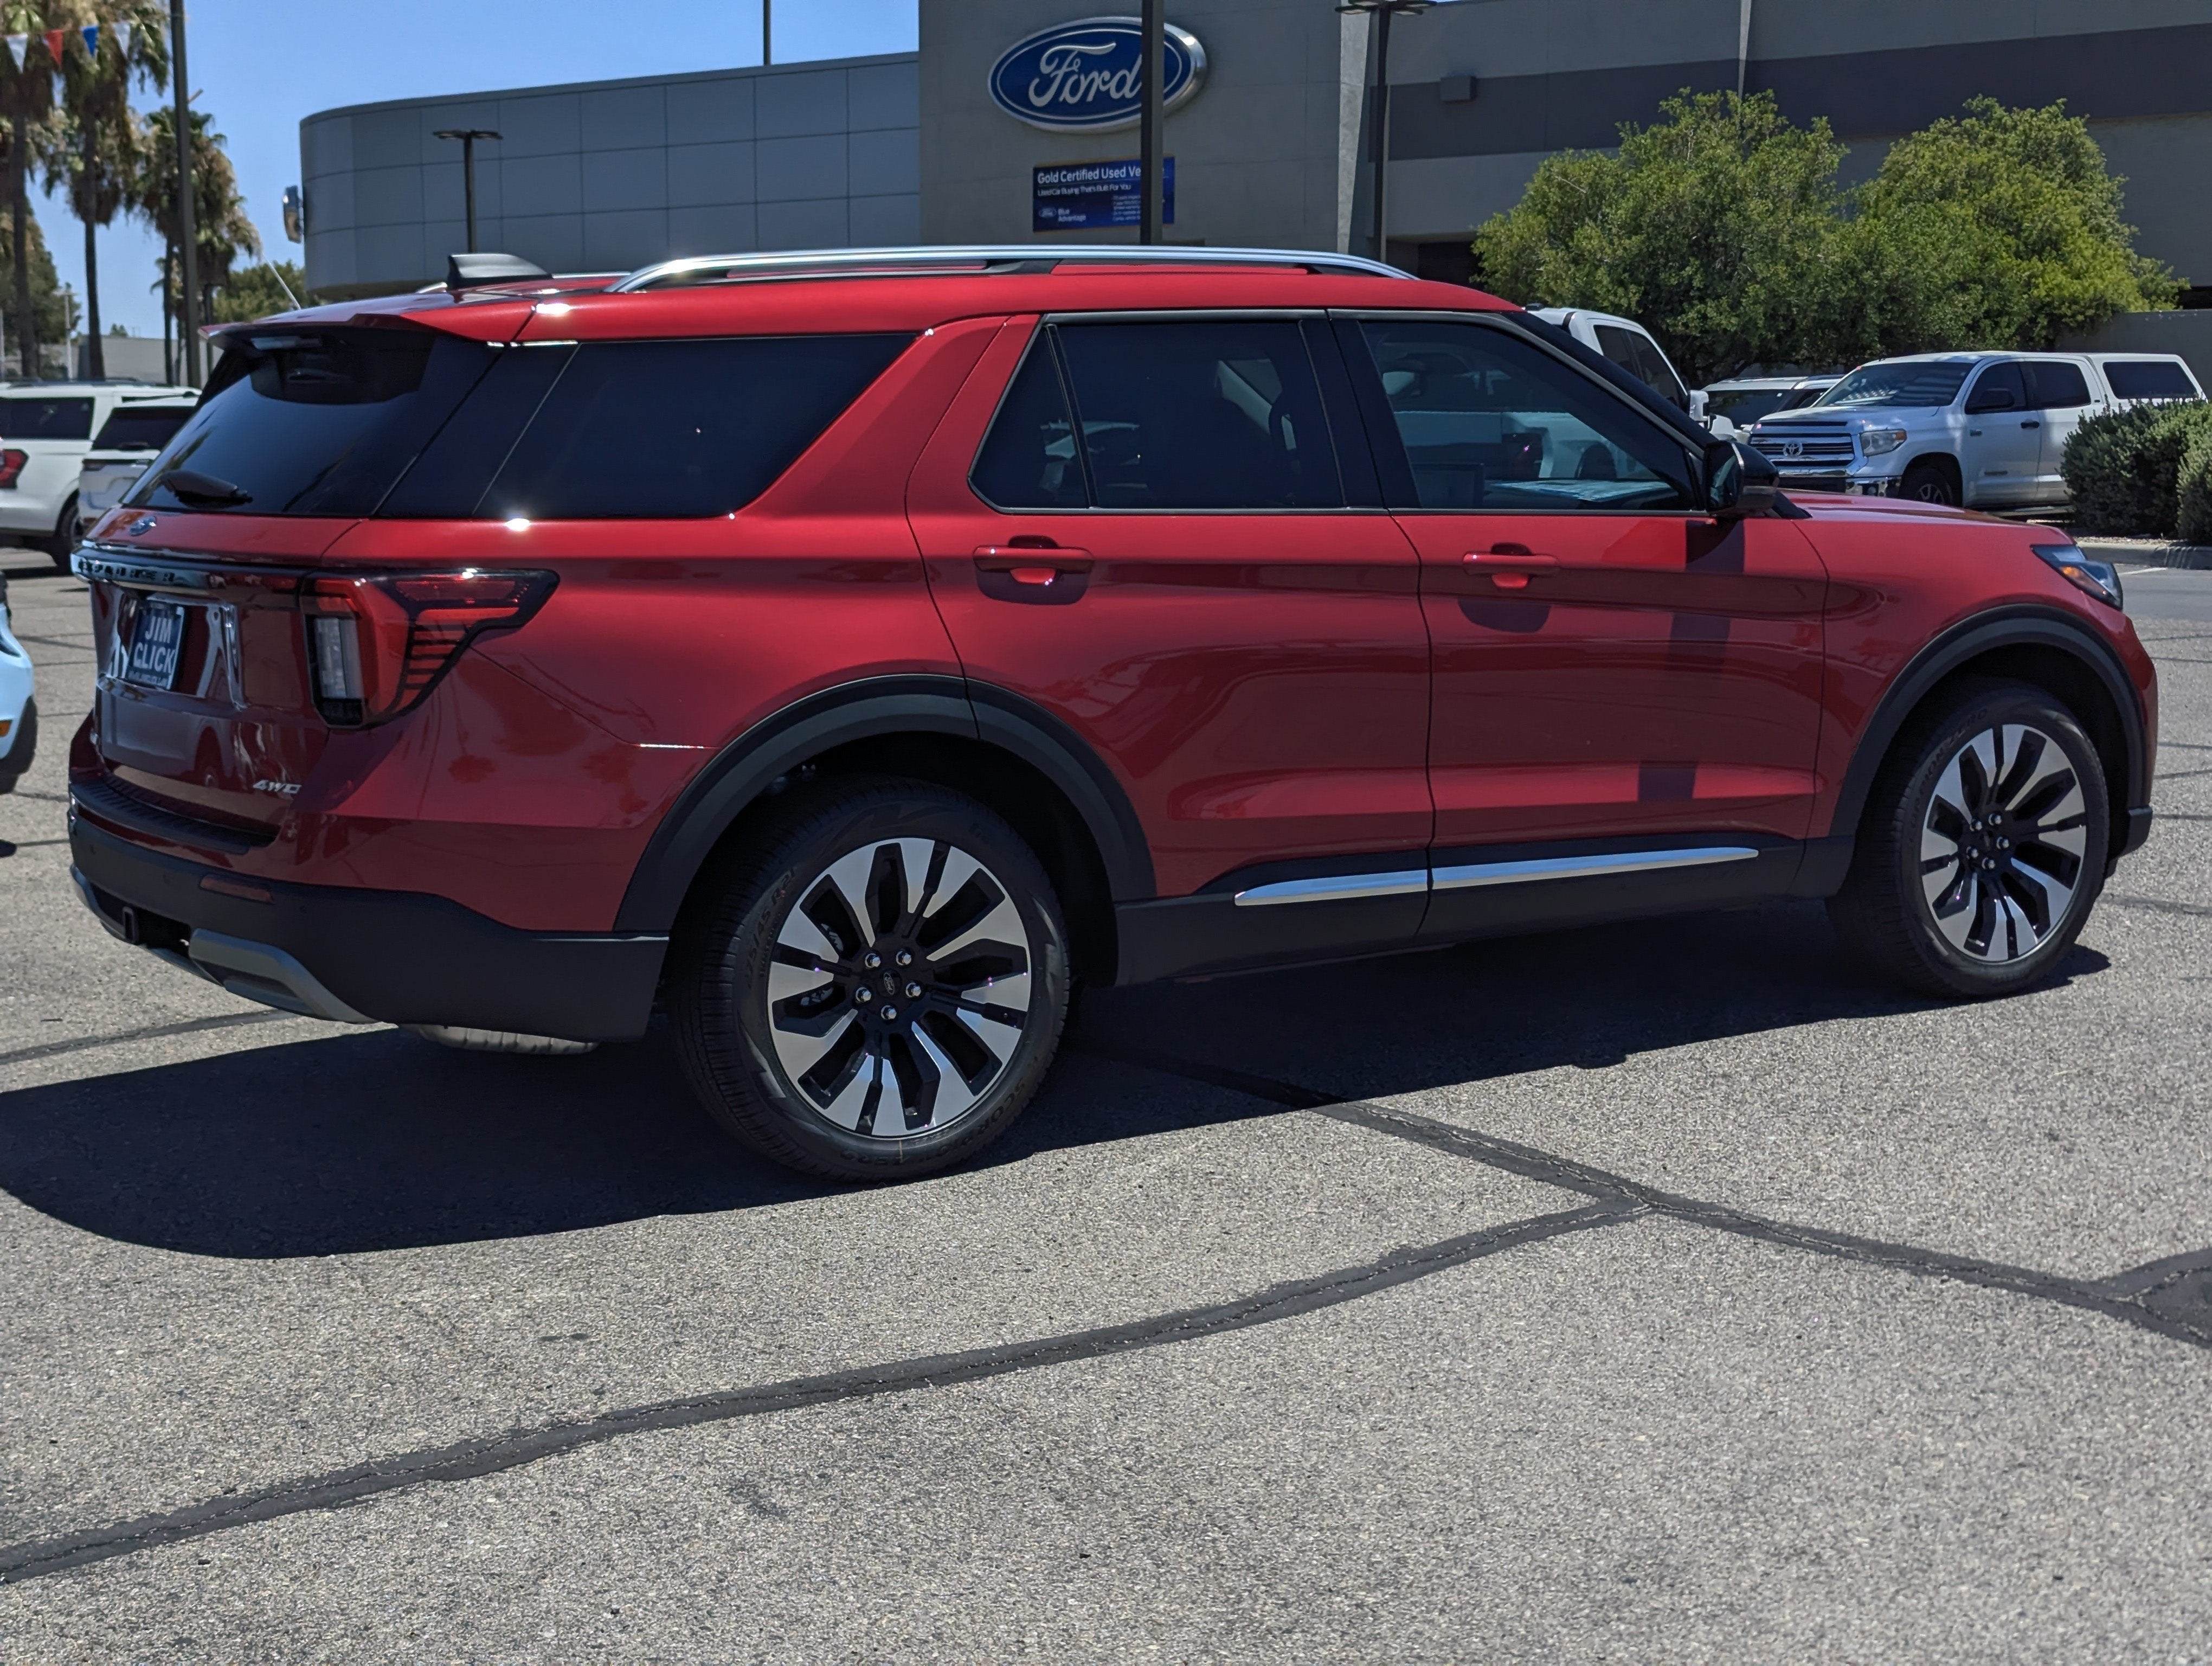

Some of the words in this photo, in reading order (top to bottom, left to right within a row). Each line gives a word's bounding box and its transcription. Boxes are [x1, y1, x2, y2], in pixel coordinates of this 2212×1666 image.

[1028, 42, 1142, 107] Ford
[1038, 171, 1058, 184] Gold
[1060, 168, 1099, 182] Certified
[1101, 166, 1126, 180] Used
[145, 616, 172, 644] JIM
[133, 642, 176, 674] CLICK
[253, 779, 302, 794] 4WD
